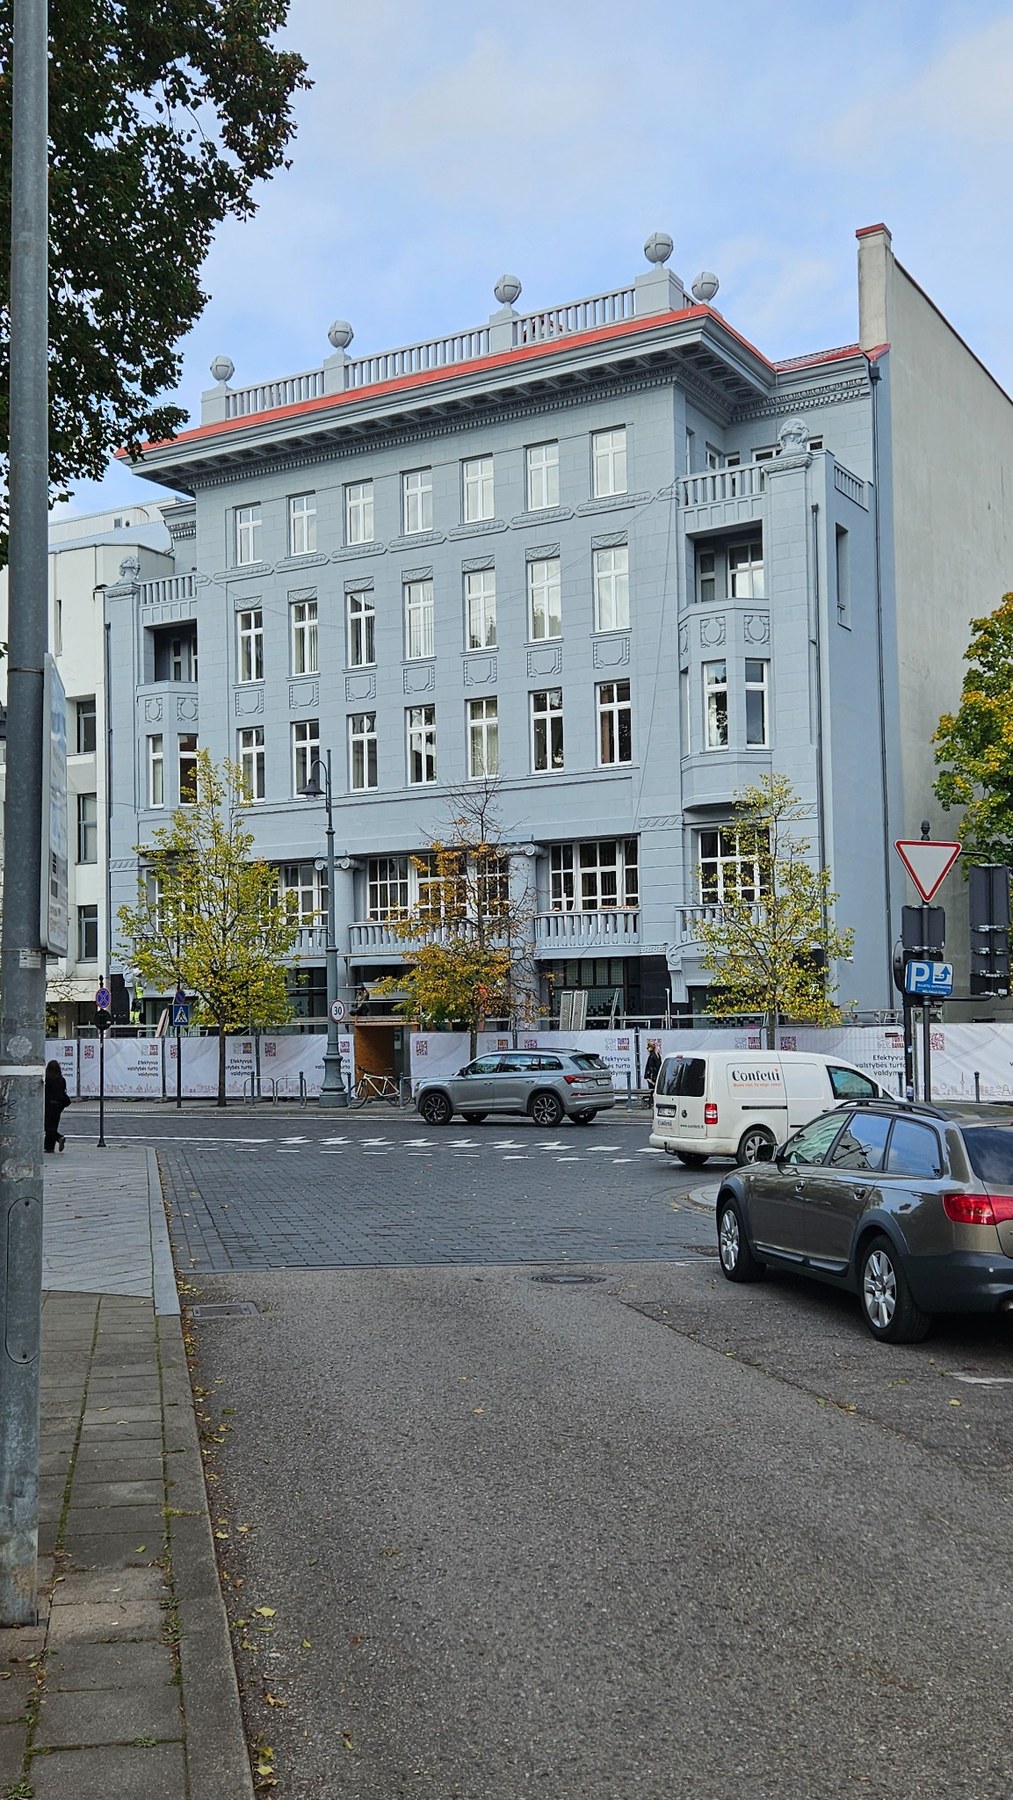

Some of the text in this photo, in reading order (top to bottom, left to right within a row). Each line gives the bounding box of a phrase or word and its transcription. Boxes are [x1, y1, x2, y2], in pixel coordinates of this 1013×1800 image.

[911, 962, 930, 991] P
[333, 1006, 342, 1016] 30
[732, 1068, 780, 1082] Confetti
